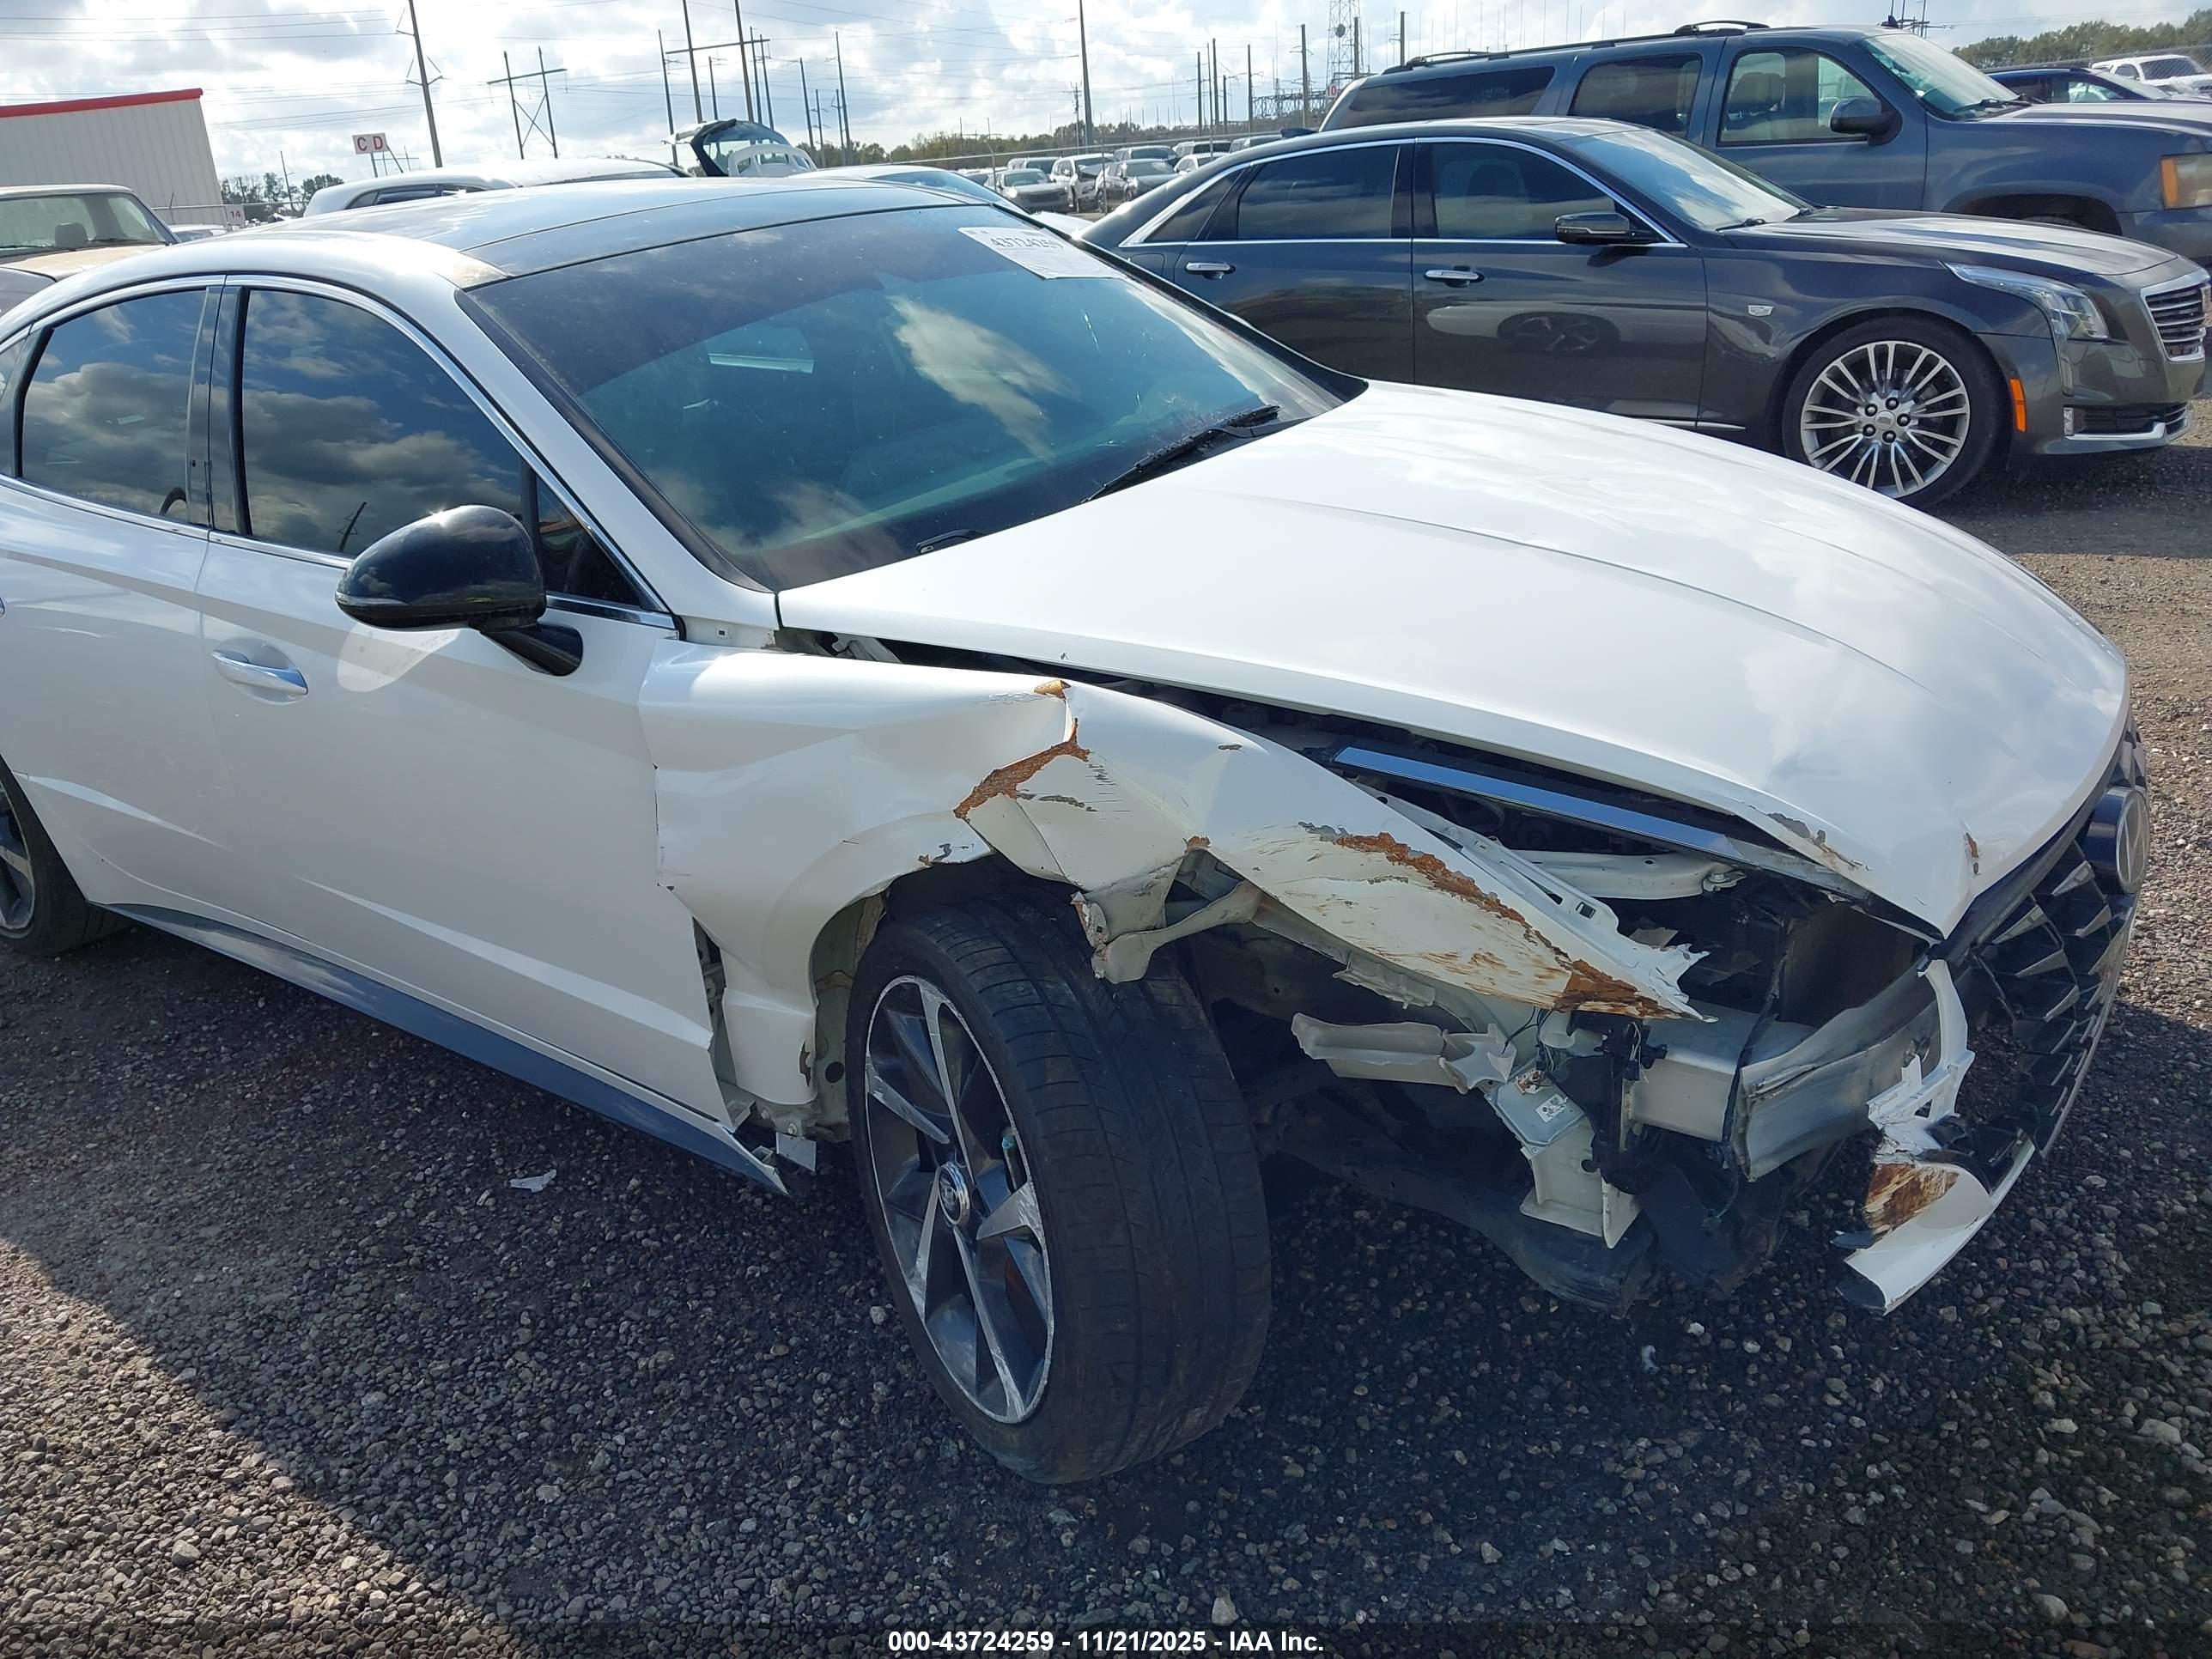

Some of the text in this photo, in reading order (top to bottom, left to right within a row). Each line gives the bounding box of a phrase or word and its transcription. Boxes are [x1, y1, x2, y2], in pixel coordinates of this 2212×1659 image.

[1327, 85, 1337, 97] 10
[356, 136, 384, 151] C D
[989, 237, 1064, 249] 43724259
